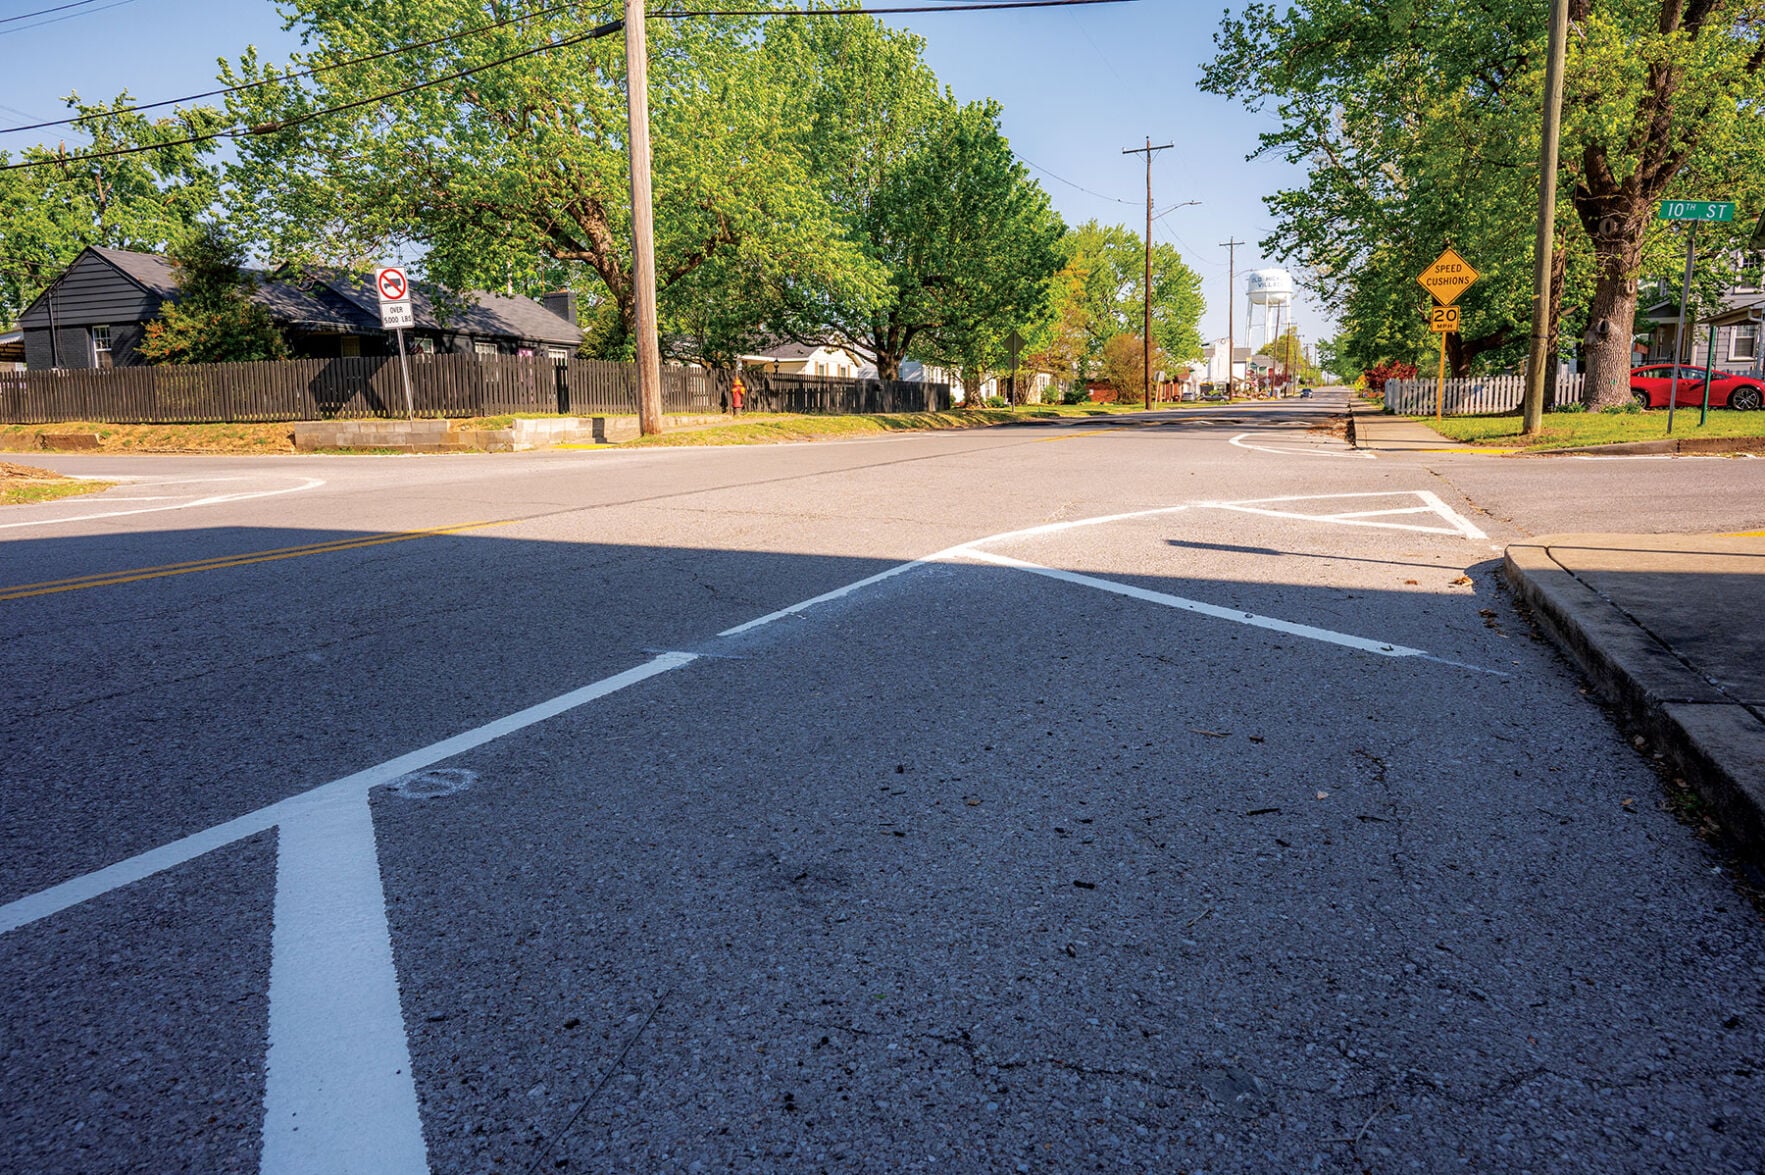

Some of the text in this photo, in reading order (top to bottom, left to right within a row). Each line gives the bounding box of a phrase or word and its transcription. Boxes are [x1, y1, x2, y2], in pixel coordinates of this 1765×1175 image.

[1667, 203, 1727, 218] 10TH ST
[1435, 264, 1462, 273] SPEED
[1426, 276, 1470, 286] CUSHIONS
[389, 306, 403, 314] OVER
[401, 315, 412, 323] LBS
[1433, 309, 1457, 322] 20
